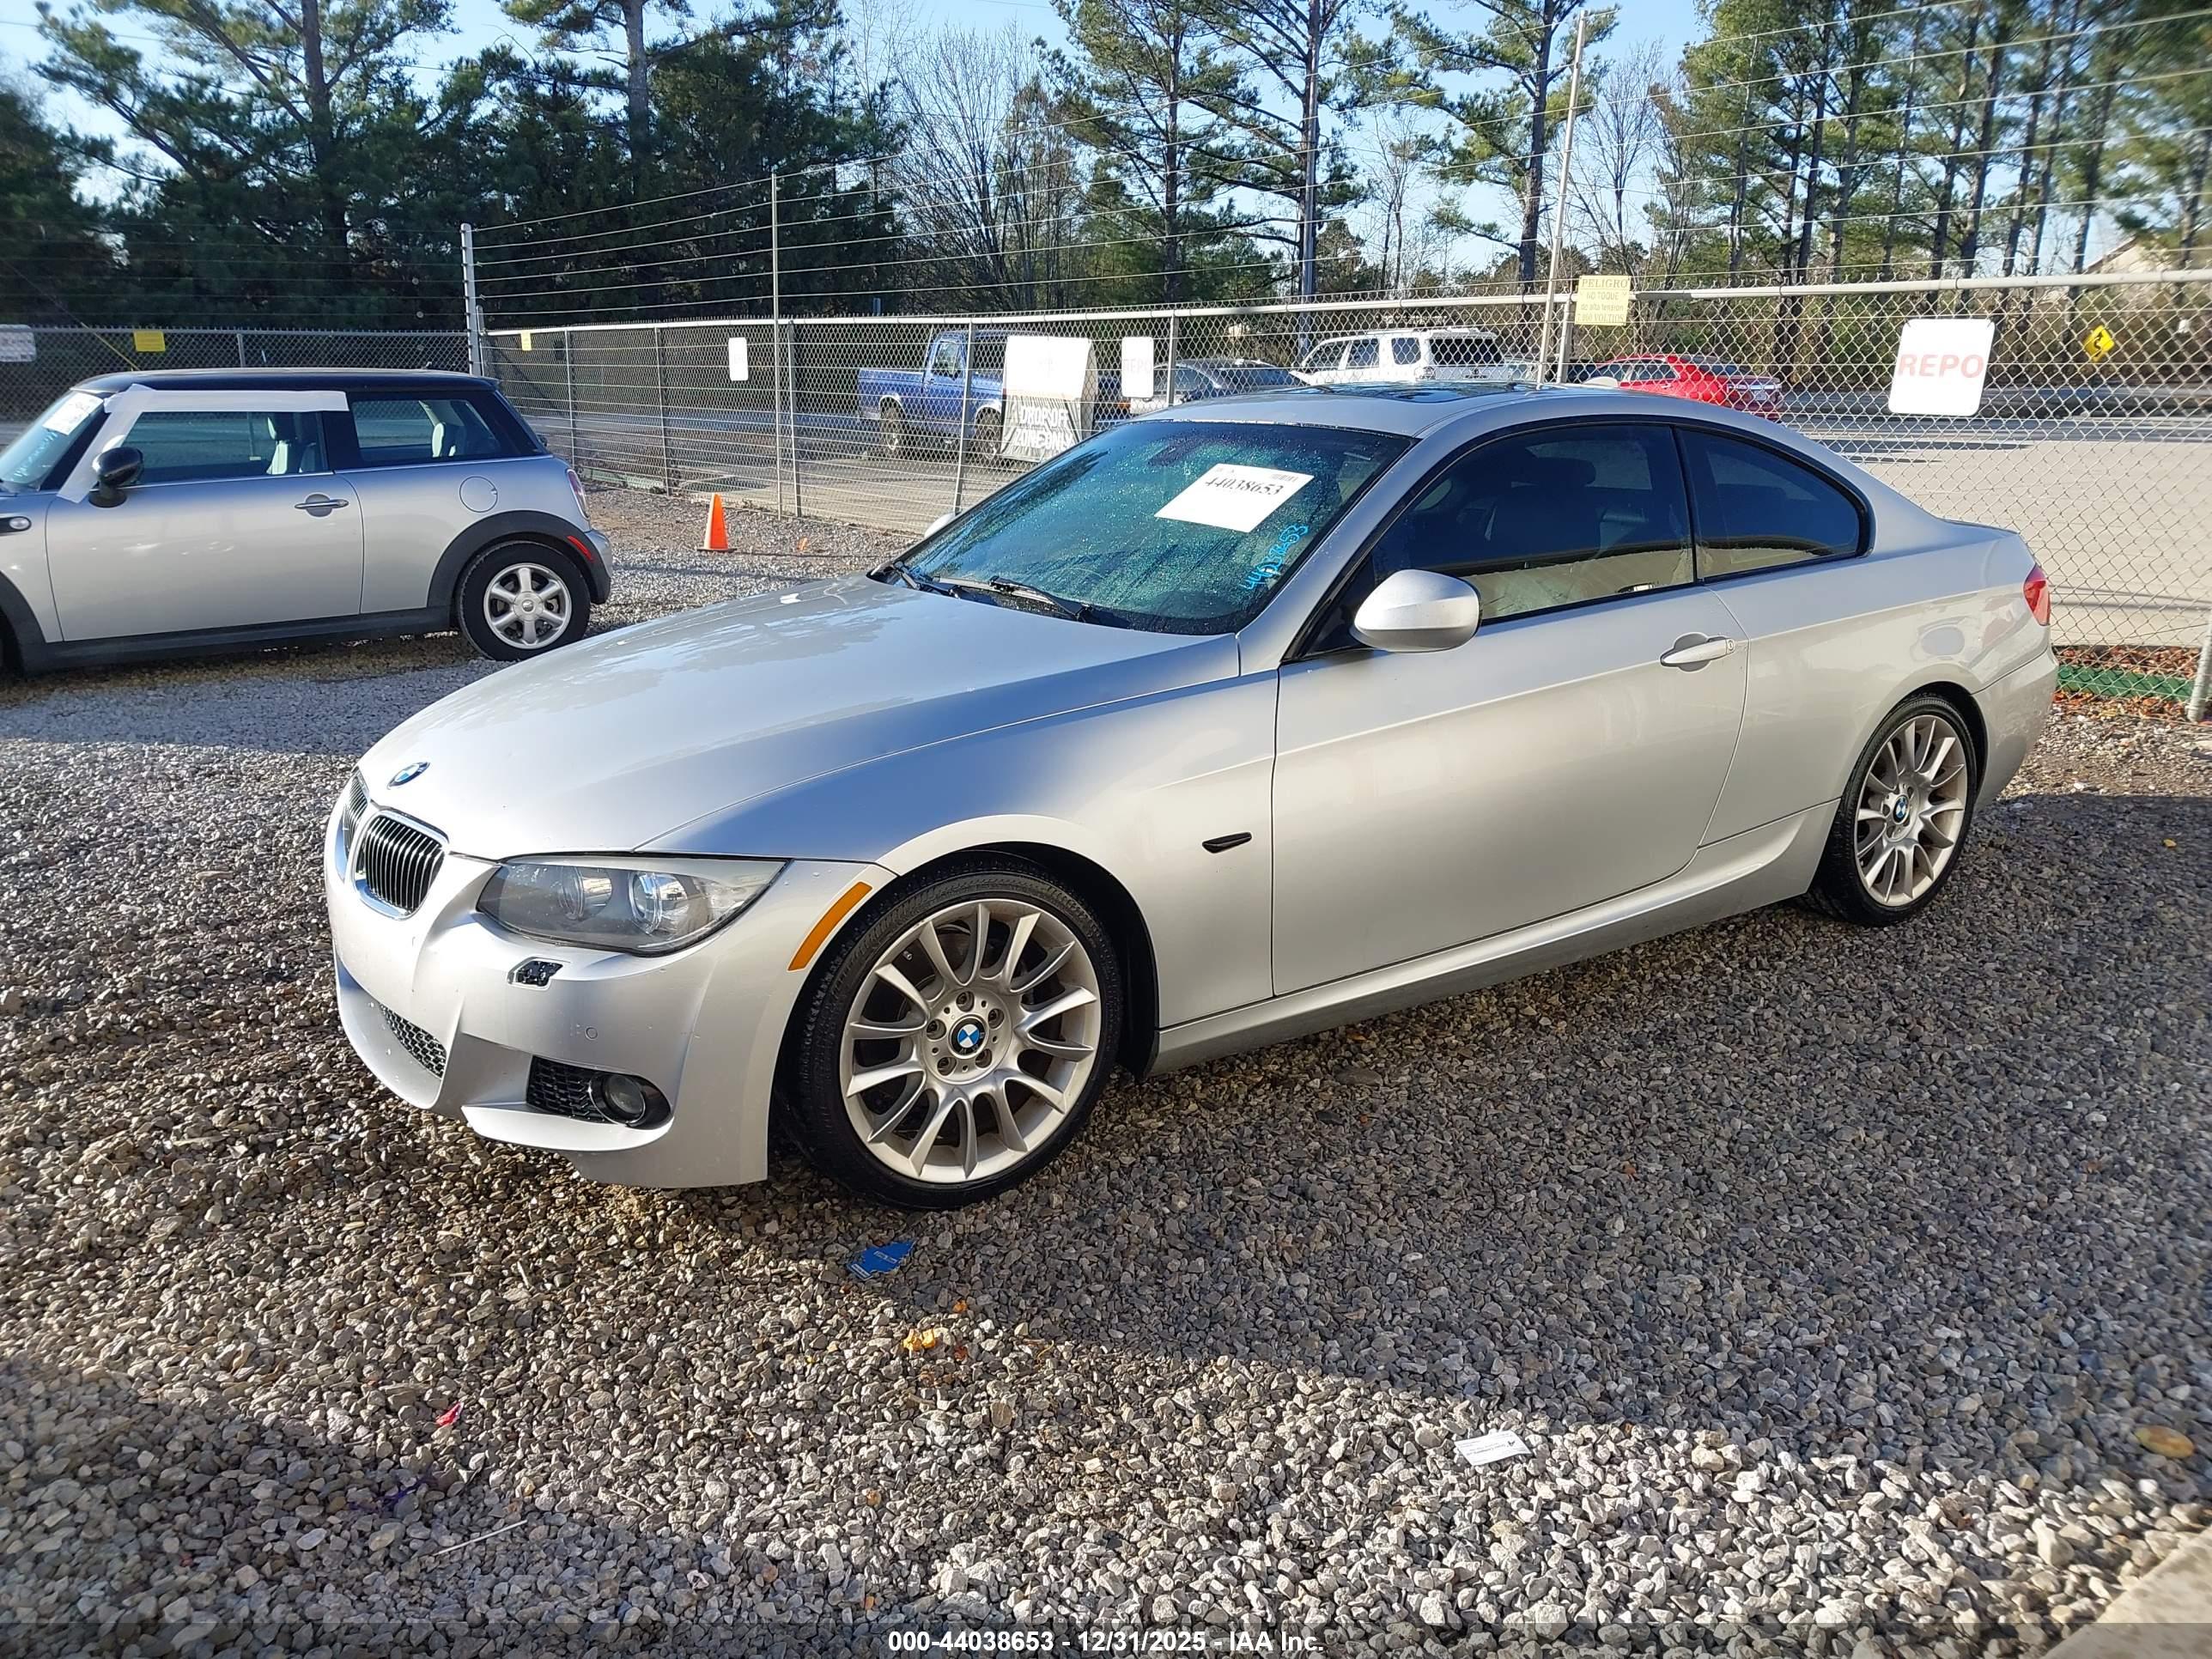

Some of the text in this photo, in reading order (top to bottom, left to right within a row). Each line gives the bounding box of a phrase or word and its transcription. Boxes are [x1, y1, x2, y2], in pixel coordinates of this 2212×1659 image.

[1581, 278, 1628, 289] PELIGRO
[1898, 354, 1984, 379] REPO
[1205, 477, 1284, 495] 44038653
